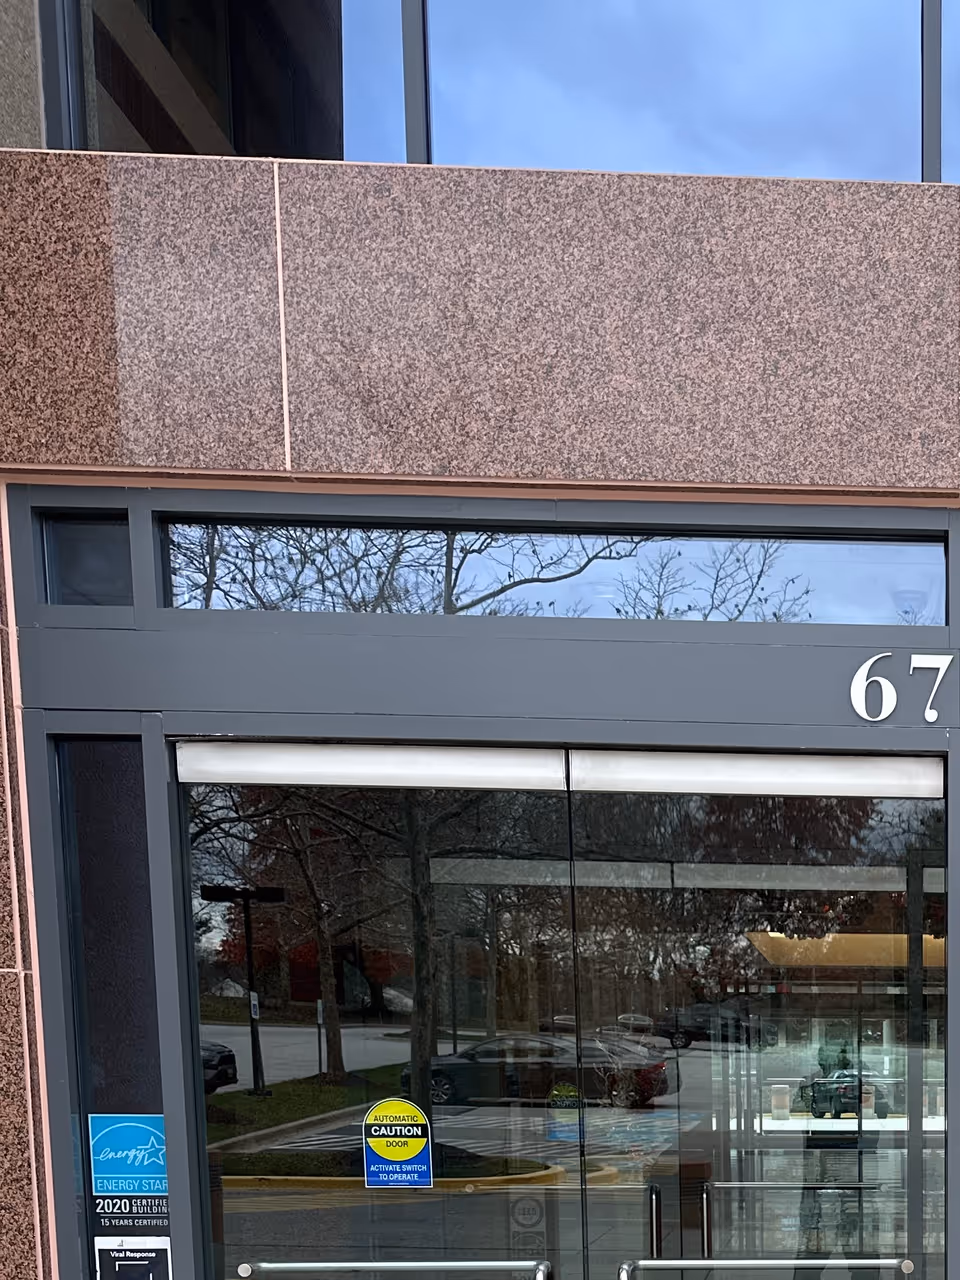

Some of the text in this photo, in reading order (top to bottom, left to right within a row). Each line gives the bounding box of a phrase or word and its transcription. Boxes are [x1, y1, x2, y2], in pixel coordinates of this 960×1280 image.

[371, 1126, 421, 1136] CAUTION
[99, 1148, 147, 1166] energy
[97, 1180, 139, 1191] ENERGY
[96, 1199, 129, 1213] 2020
